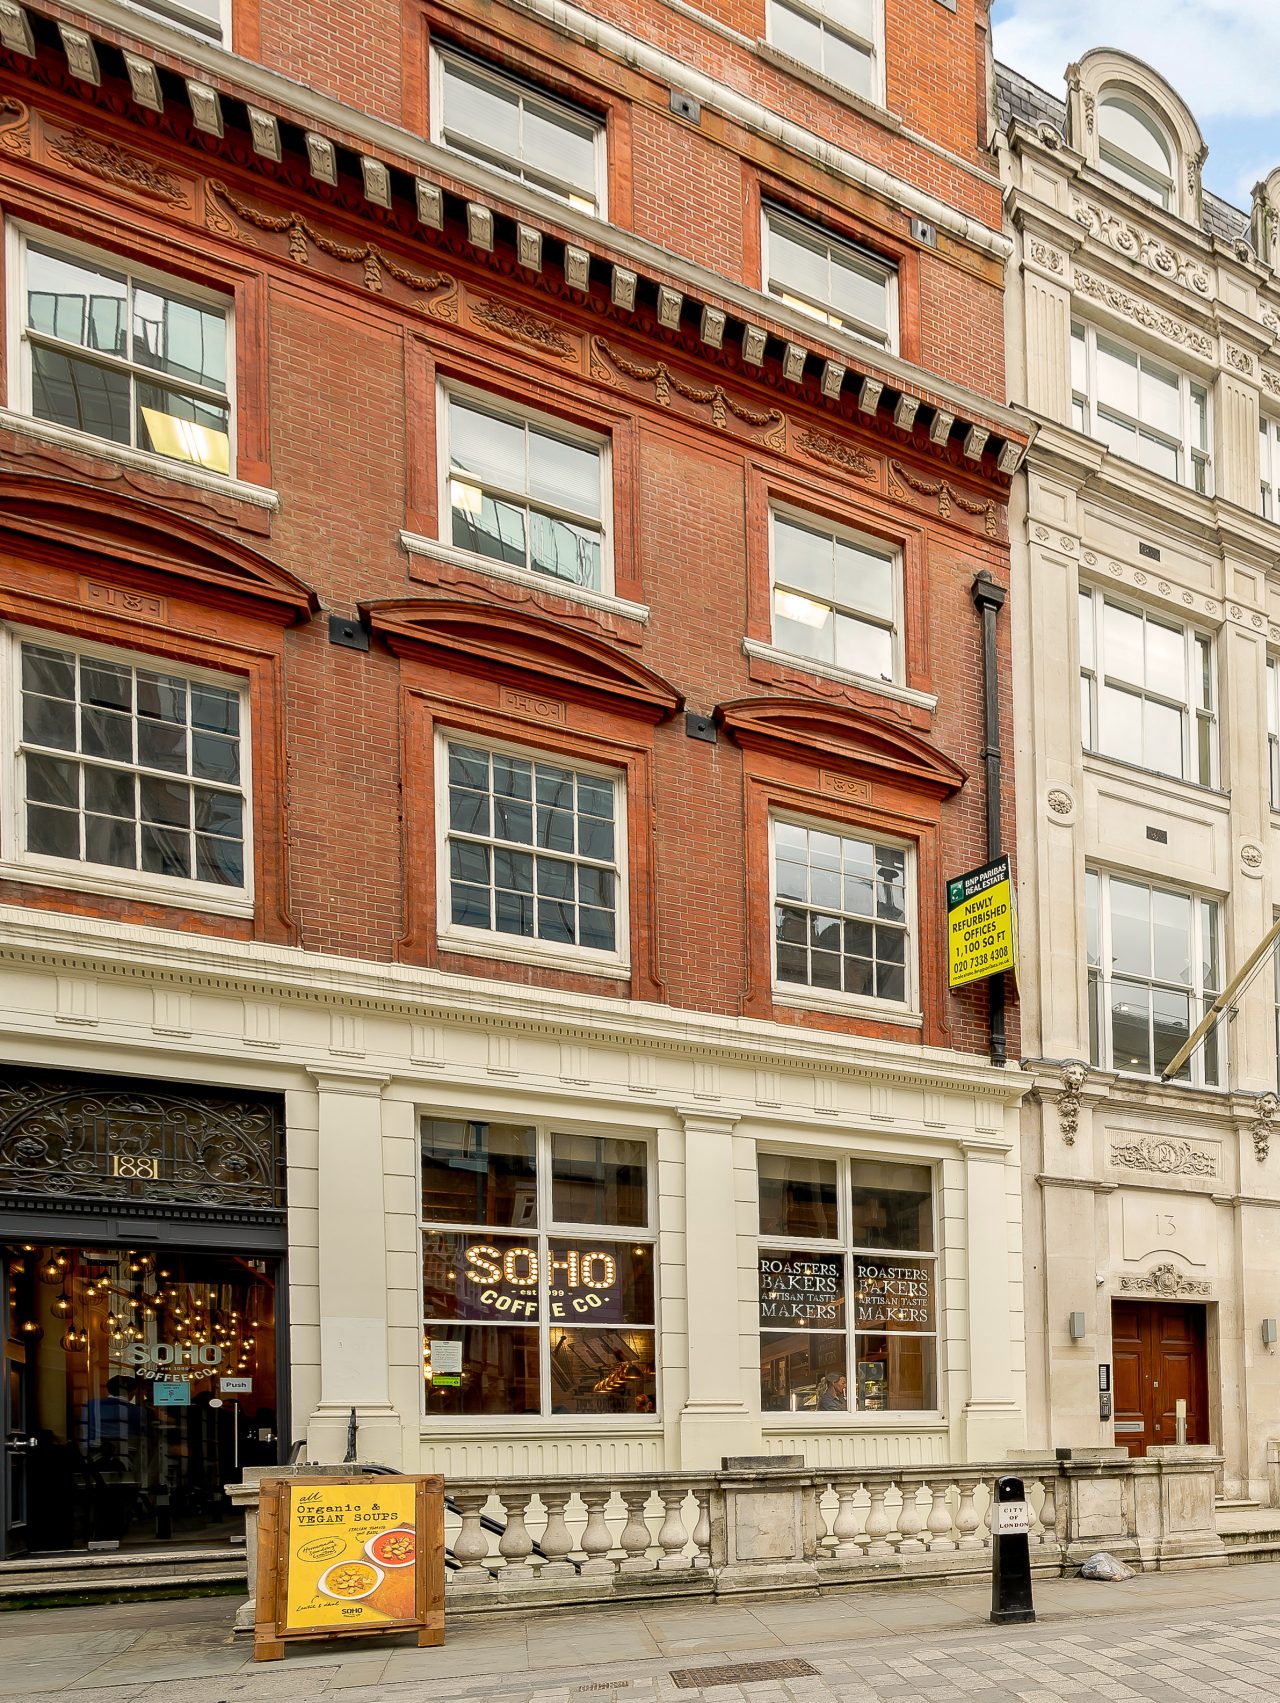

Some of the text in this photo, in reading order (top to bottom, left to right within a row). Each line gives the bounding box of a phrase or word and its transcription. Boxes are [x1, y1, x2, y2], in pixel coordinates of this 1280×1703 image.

[965, 863, 1007, 888] BNP PARIBAS
[965, 872, 1005, 896] REAL ESTATE
[965, 895, 994, 916] NEWLY
[953, 904, 1007, 934] REFURBISHED
[964, 921, 997, 942] OFFICES
[956, 930, 1006, 958] 1,100 SQ FT
[953, 945, 1008, 973] 020 7338 4308
[113, 1155, 158, 1179] 1881
[1155, 1214, 1176, 1236] 13
[465, 1245, 616, 1288] SOHO
[761, 1260, 839, 1277] ROASTERS,
[857, 1266, 930, 1281] ROASTERS,
[480, 1289, 610, 1317] COFFE CO.
[761, 1291, 836, 1303] ARTISAN TASTE
[859, 1297, 928, 1306] ARTISAN TASTE
[761, 1303, 836, 1319] MAKERS
[859, 1307, 928, 1323] MAKERS
[127, 1343, 222, 1365] SOHO
[136, 1368, 190, 1382] COFFEE
[300, 1491, 322, 1502] all
[297, 1503, 361, 1514] Organic
[297, 1512, 399, 1524] VEGAN SOUPS
